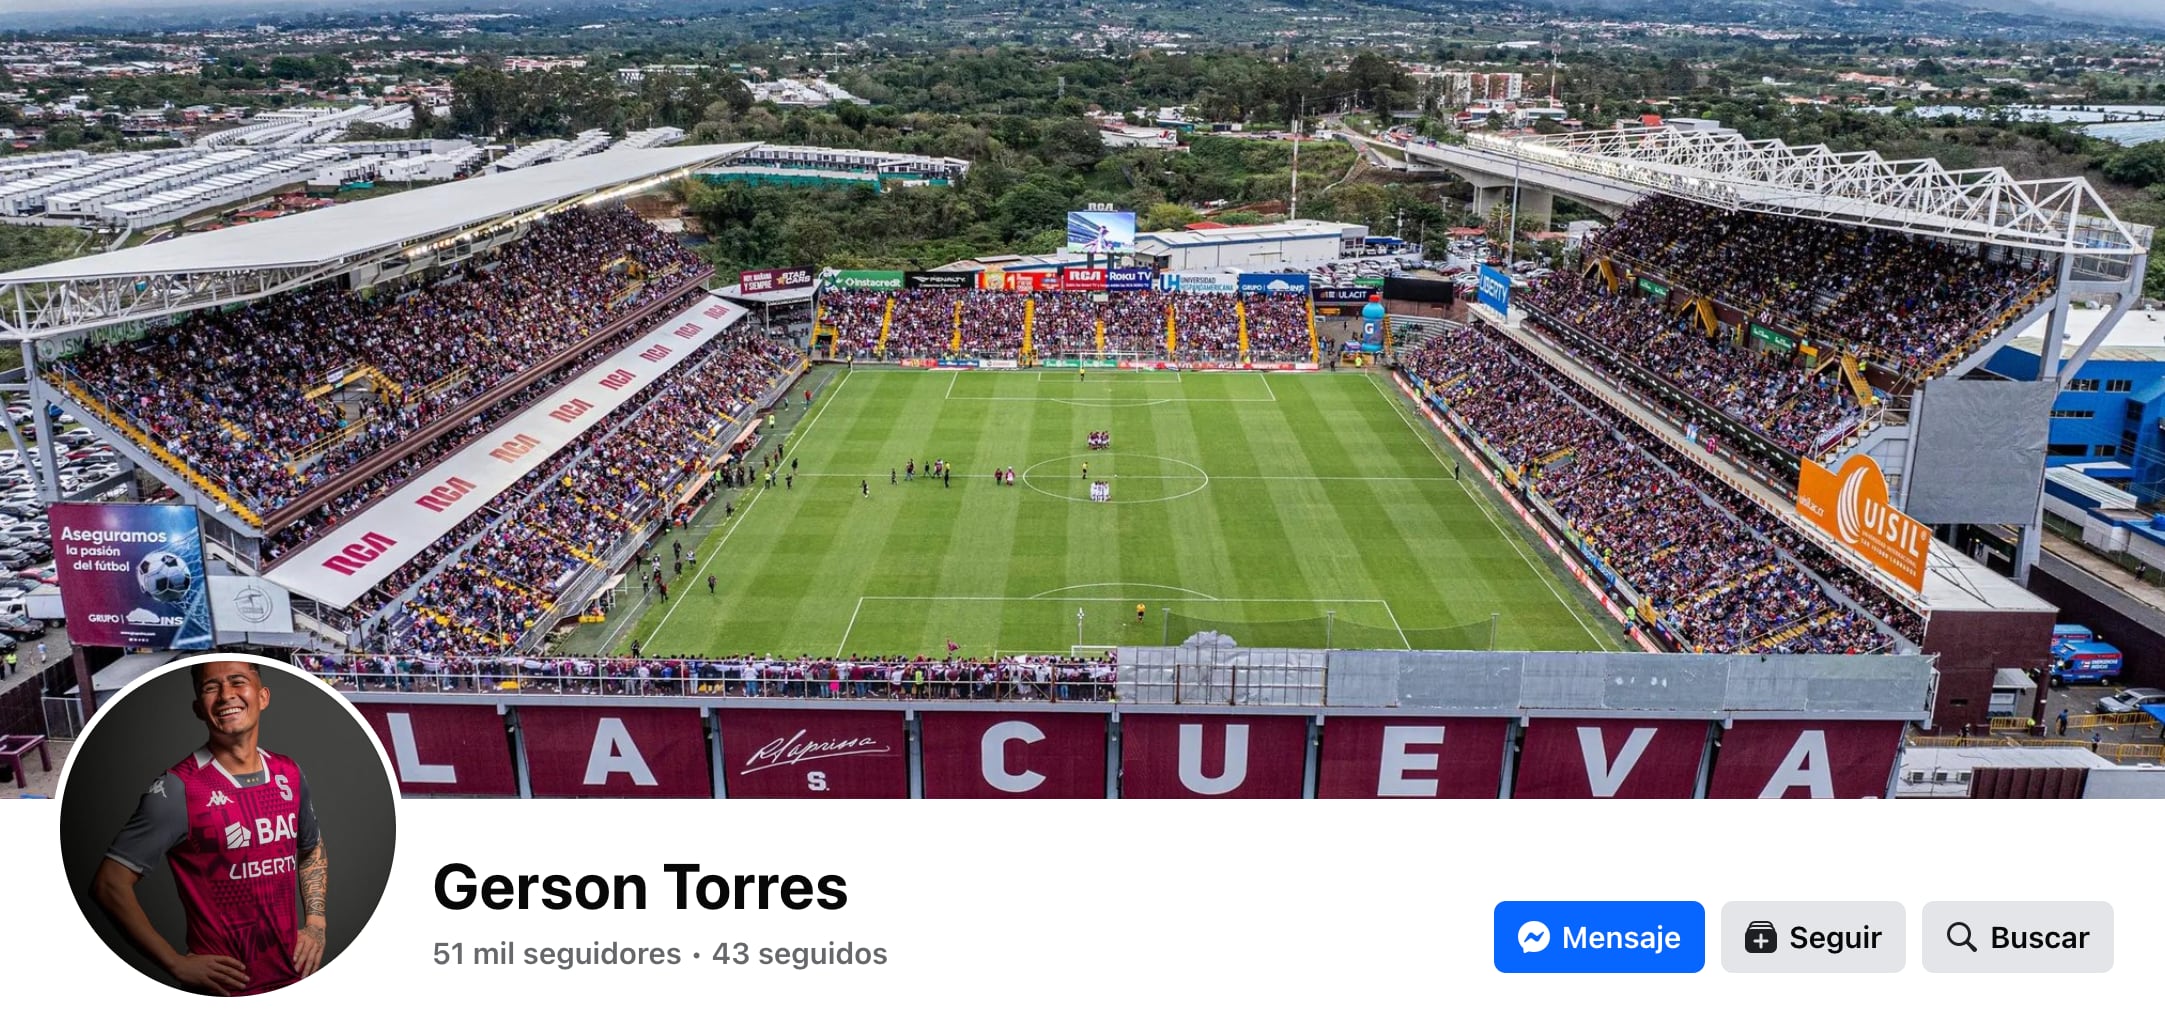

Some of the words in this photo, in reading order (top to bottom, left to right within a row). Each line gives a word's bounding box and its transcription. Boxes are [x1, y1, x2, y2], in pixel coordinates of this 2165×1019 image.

[1088, 203, 1114, 211] RCA
[782, 271, 806, 280] STAR
[785, 275, 811, 285] CARS
[1069, 271, 1101, 281] RCA
[1137, 271, 1152, 281] TV
[1180, 276, 1217, 284] UNIVERSIDAD
[1338, 290, 1368, 299] ULACIT
[1479, 273, 1509, 304] LIBERTY
[703, 304, 730, 320] RCA
[674, 322, 704, 340] RCA
[639, 343, 673, 363] RCA
[599, 368, 636, 391] RCA
[549, 398, 594, 423] RCA
[489, 433, 541, 464] RCA
[415, 476, 477, 513] RCA
[61, 526, 167, 545] Aseguramos
[1864, 497, 1920, 558] UISIL
[66, 544, 77, 556] la
[80, 545, 121, 557] pasión
[322, 531, 397, 576] RCA
[73, 560, 93, 571] del
[95, 561, 130, 573] fútbol
[88, 614, 120, 624] GRUPO
[160, 616, 184, 626] INS
[255, 812, 298, 845] BAC
[229, 855, 297, 880] LIBERTY
